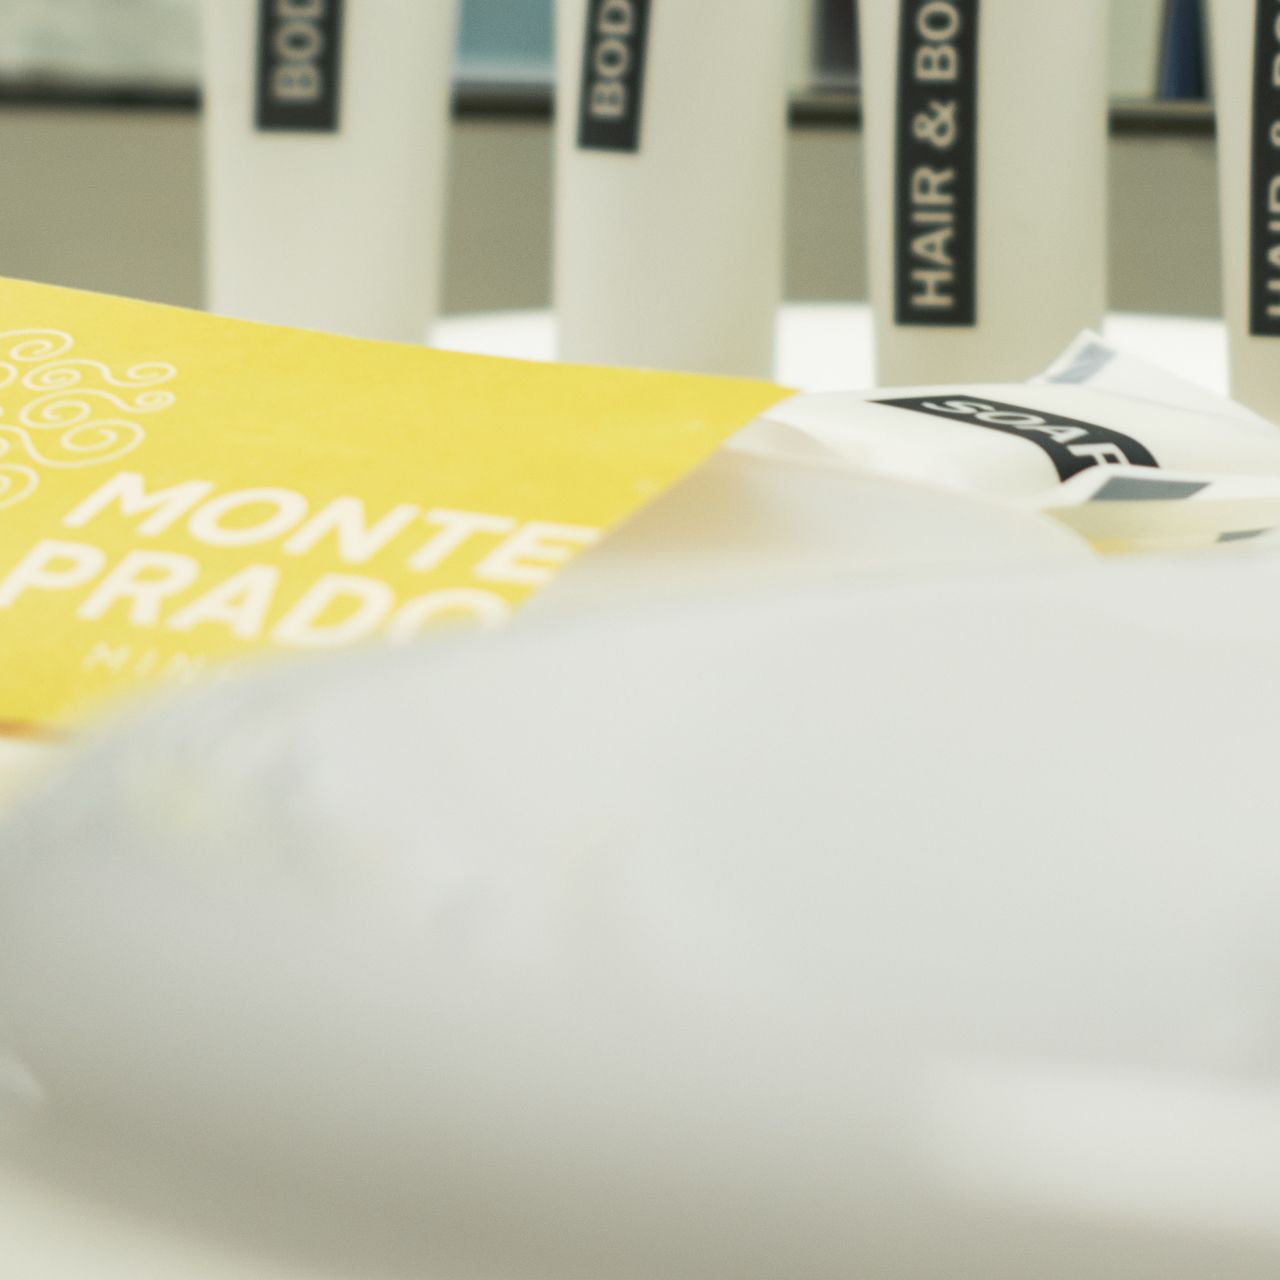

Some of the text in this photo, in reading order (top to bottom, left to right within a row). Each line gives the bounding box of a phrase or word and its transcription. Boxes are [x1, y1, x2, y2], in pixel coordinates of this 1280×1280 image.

[910, 100, 958, 149] &
[911, 166, 955, 310] HAIR
[62, 470, 604, 588] MONTE
